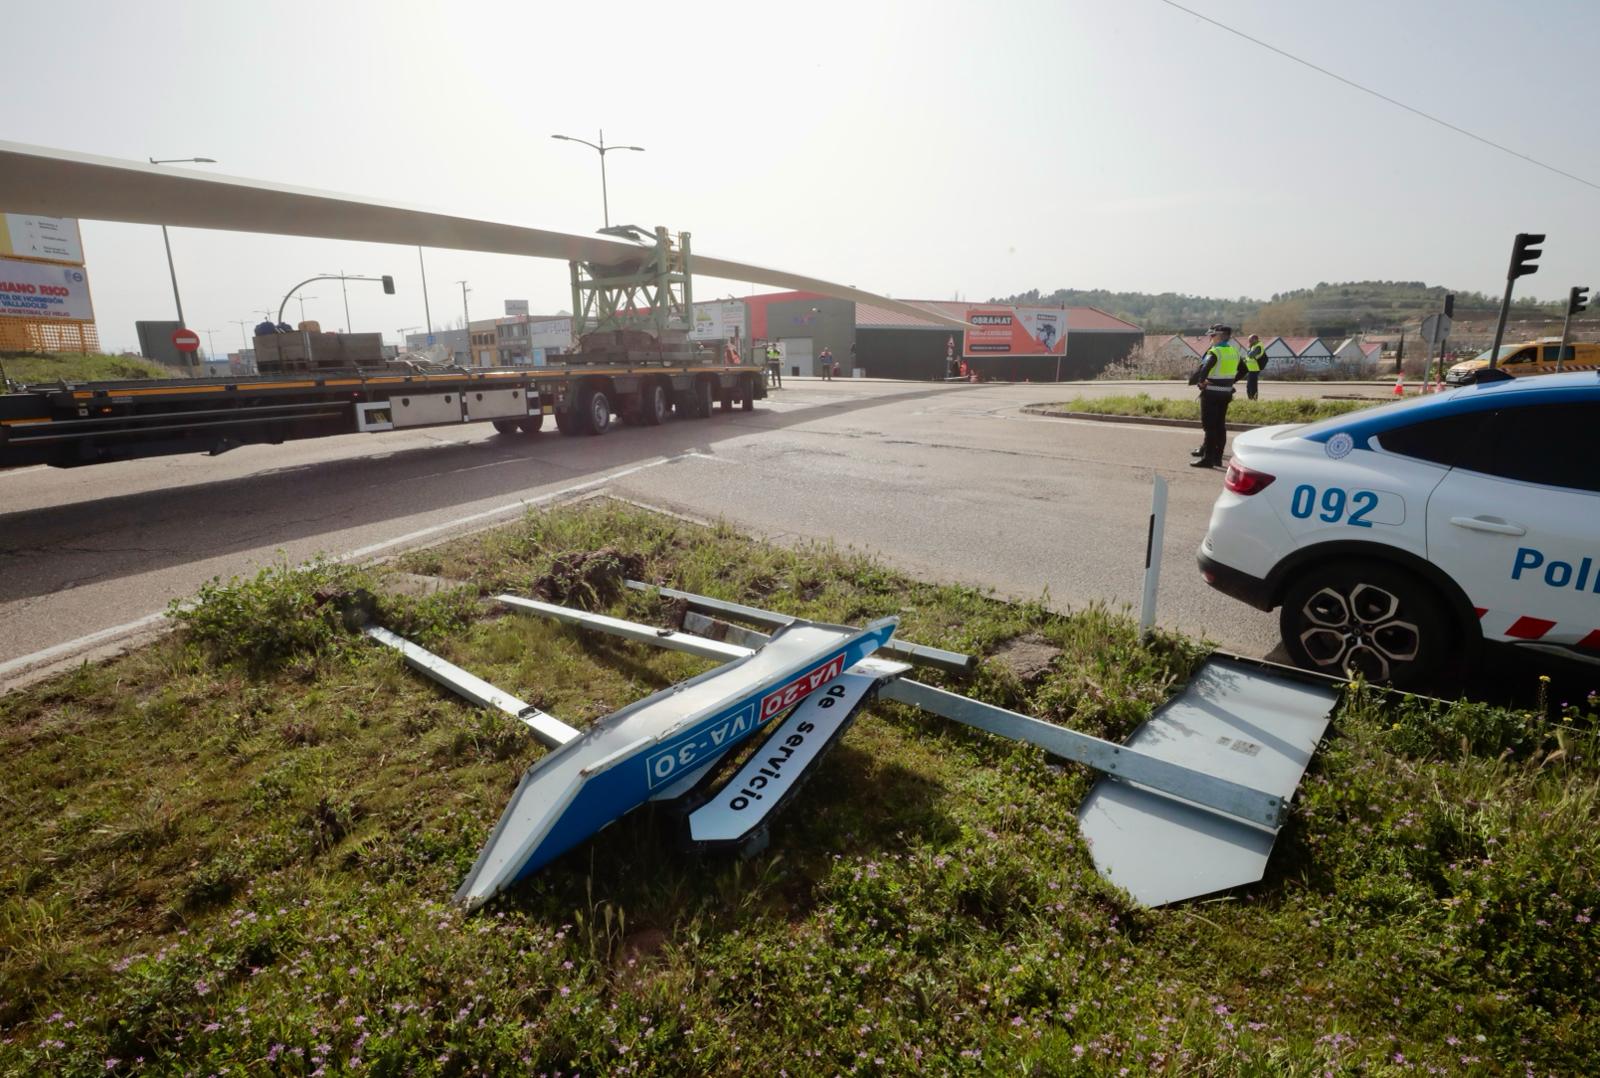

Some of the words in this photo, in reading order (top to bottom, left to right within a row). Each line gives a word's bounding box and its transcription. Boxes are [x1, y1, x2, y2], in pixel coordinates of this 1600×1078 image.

[39, 285, 69, 297] RICO
[972, 316, 1011, 324] OBRAMAT
[1291, 484, 1379, 528] 092
[766, 661, 839, 714] VA-20
[818, 684, 846, 709] de
[654, 715, 746, 777] VA-30
[730, 720, 815, 811] servicio
